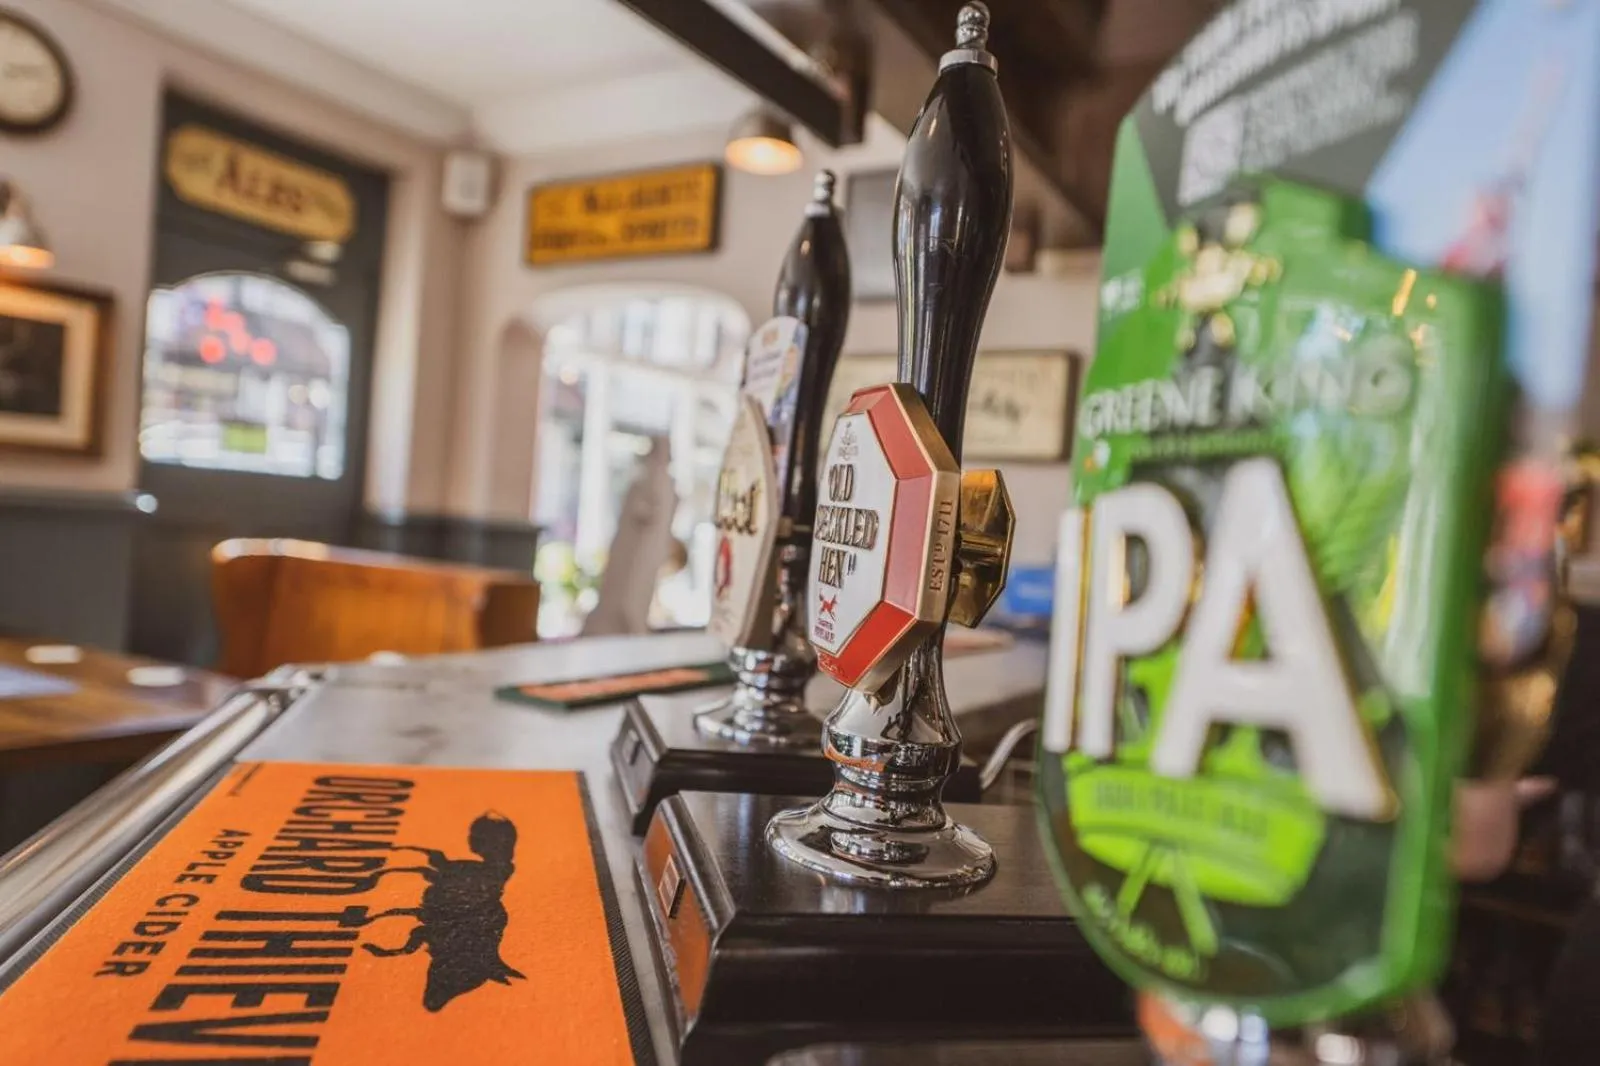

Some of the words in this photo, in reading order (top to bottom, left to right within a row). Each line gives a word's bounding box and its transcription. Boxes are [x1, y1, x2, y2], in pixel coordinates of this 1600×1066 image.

[1081, 366, 1222, 438] GREENE
[937, 500, 953, 536] 1711
[1043, 456, 1398, 819] IPA
[174, 829, 253, 885] APPLE
[240, 774, 415, 896] ORCHARD
[94, 894, 200, 978] CIDER
[107, 905, 370, 1066] THIEV
